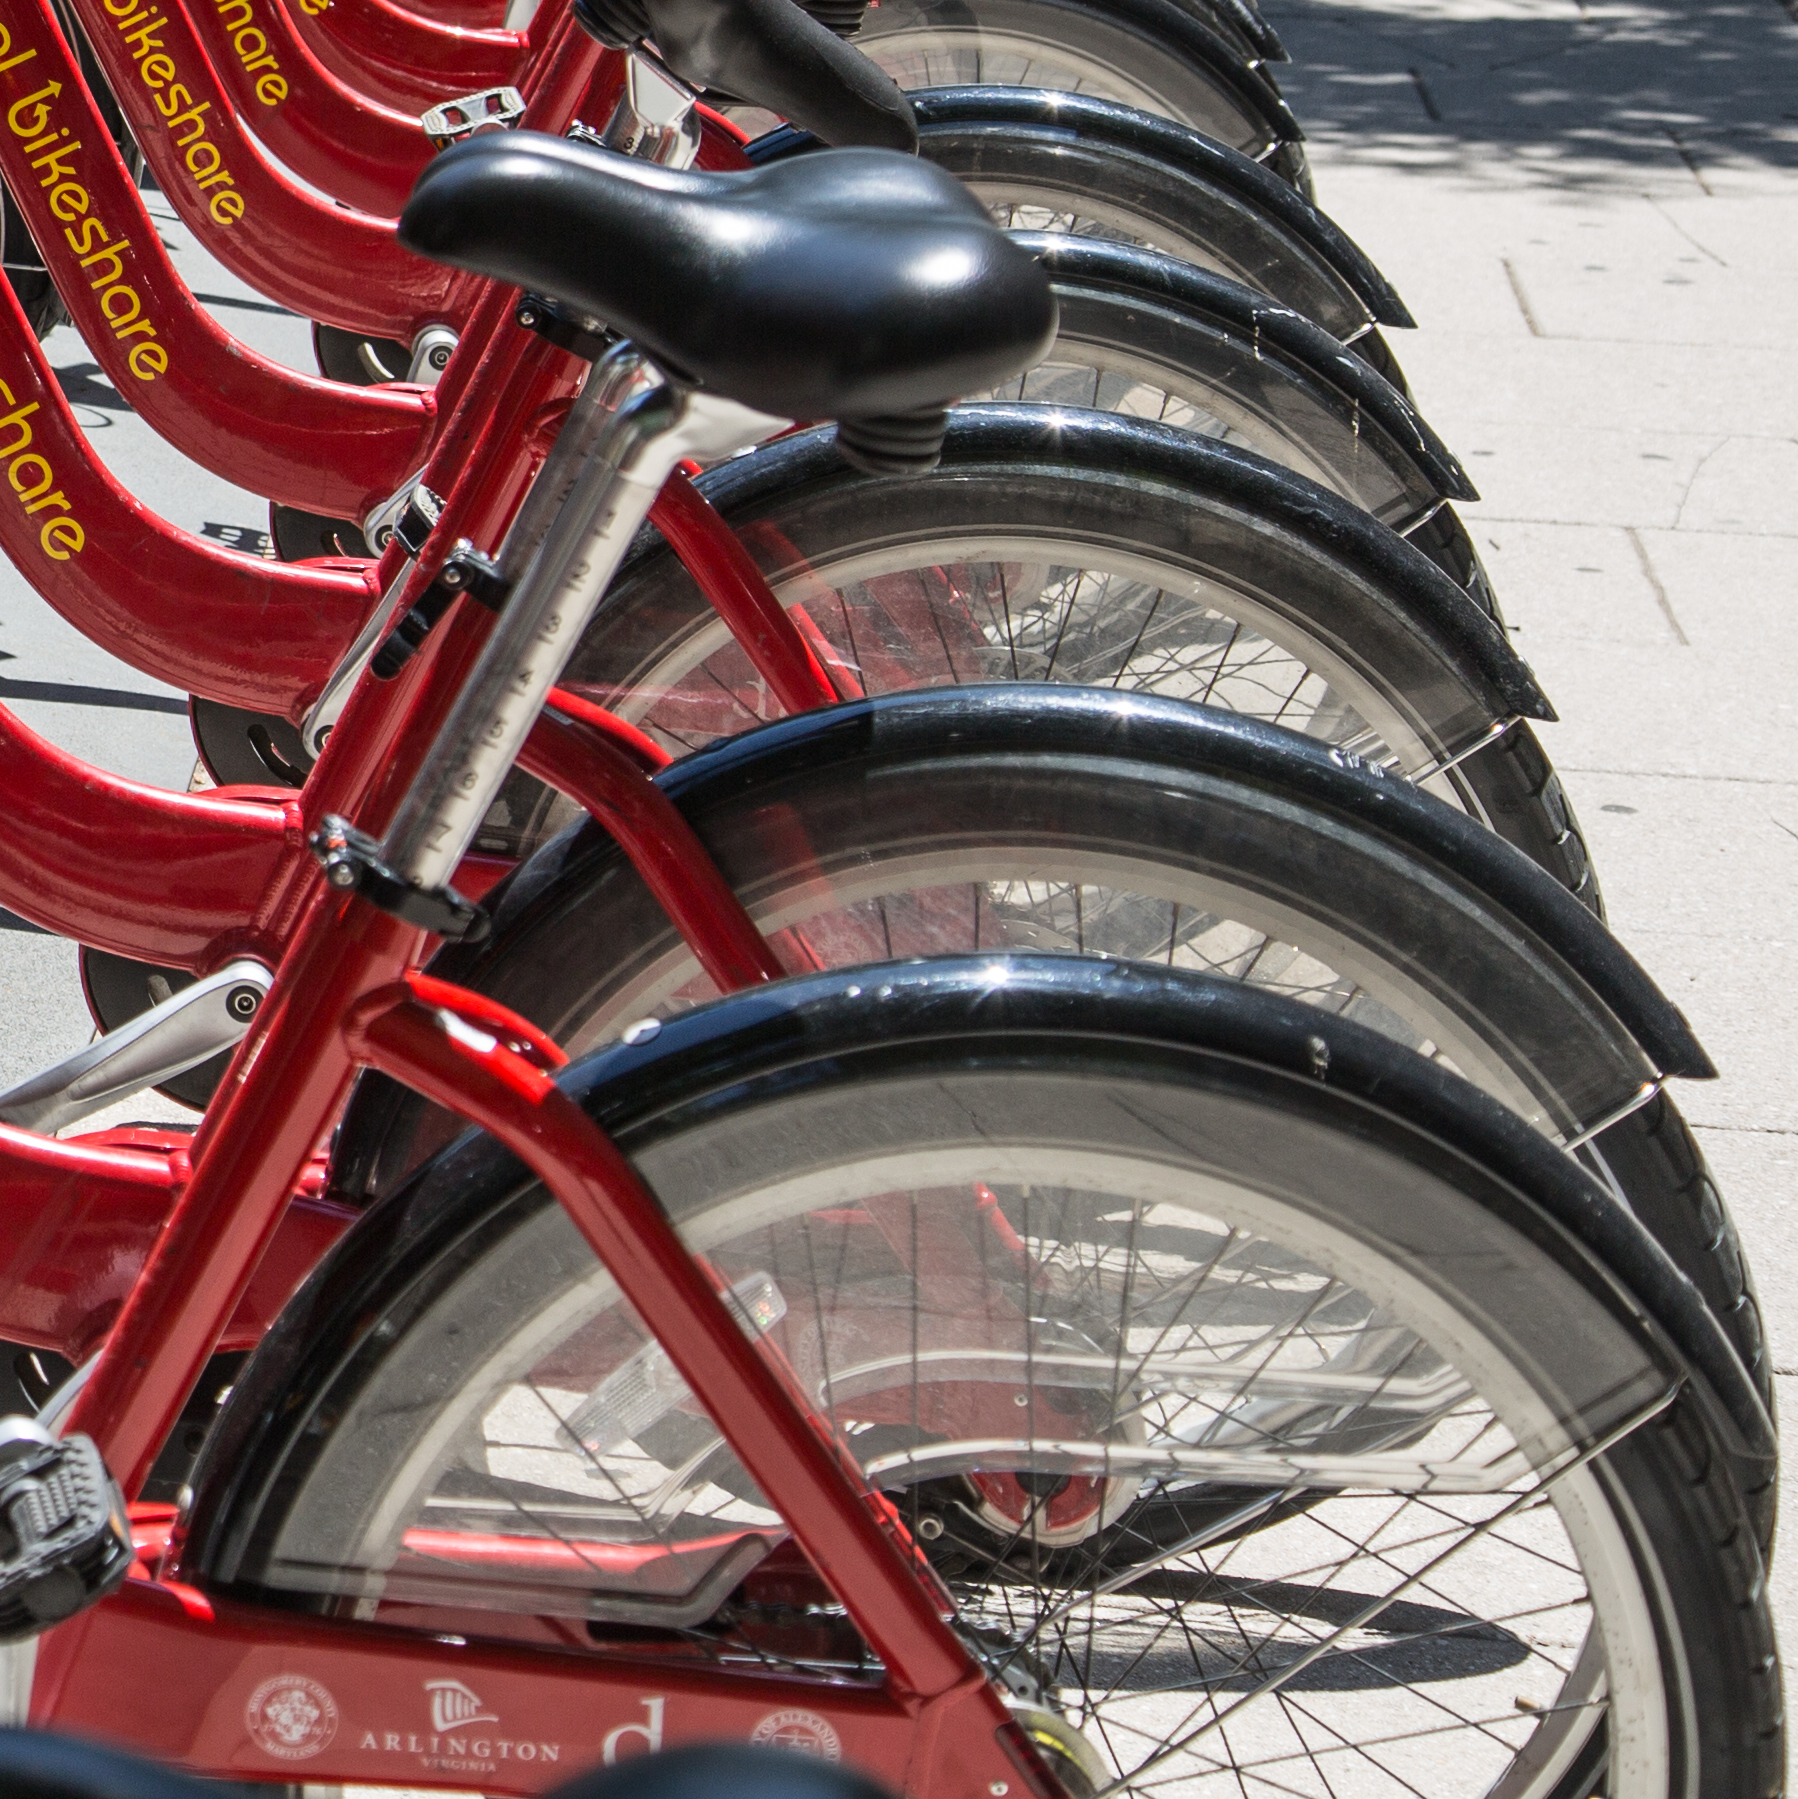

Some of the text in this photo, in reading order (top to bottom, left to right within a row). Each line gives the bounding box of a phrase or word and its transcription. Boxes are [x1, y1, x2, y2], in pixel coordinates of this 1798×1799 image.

[9, 80, 168, 381] bikeshare
[360, 1731, 560, 1762] ARLINGTON
[420, 1757, 496, 1773] VIRGINIA
